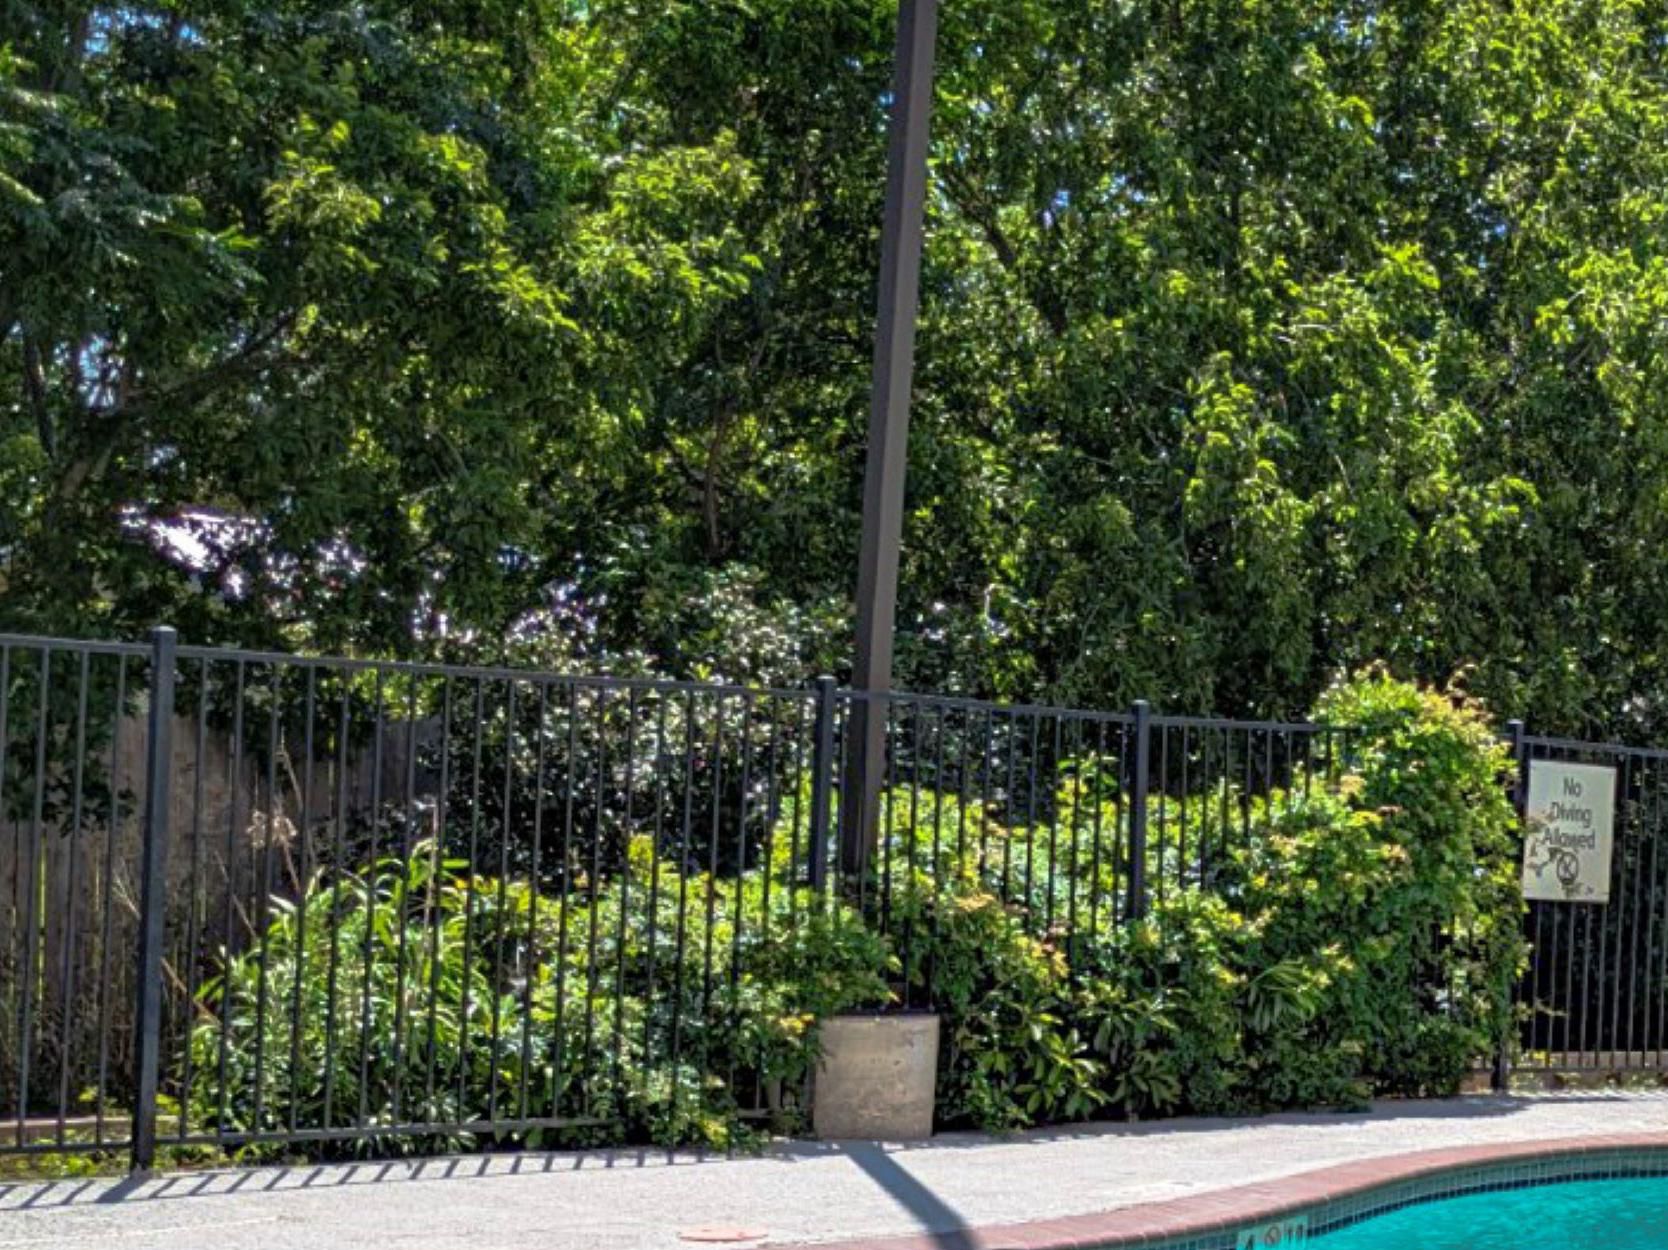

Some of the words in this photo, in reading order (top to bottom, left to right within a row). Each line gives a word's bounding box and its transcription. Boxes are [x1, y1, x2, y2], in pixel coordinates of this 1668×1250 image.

[1563, 777, 1582, 796] No
[1551, 802, 1593, 828] Diving
[1542, 828, 1596, 850] Allowed
